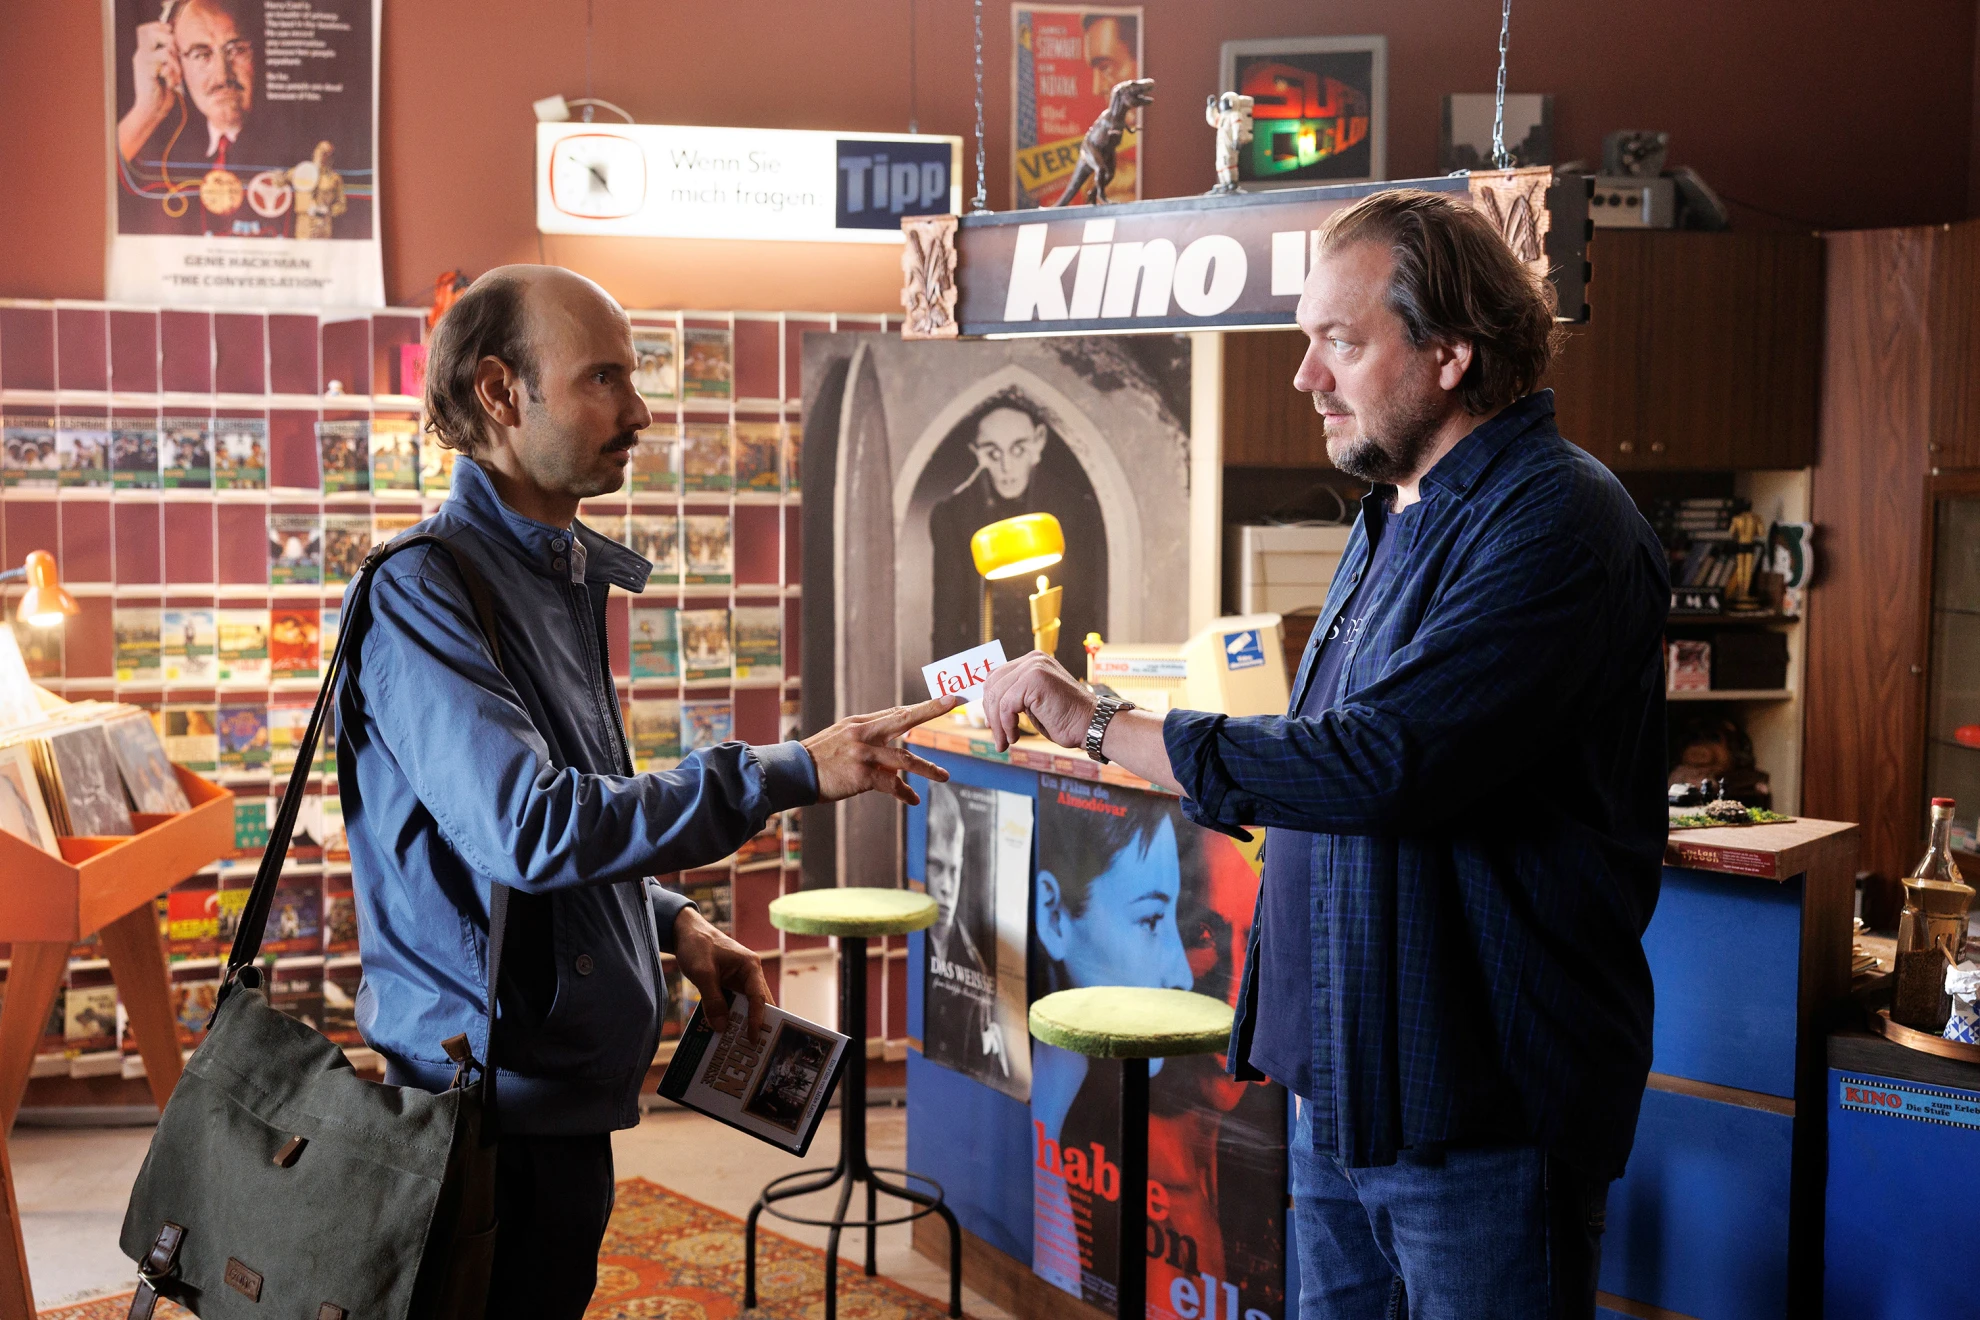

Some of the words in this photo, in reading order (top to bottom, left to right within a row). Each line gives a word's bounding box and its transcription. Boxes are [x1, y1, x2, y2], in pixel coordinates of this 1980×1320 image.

[670, 150, 740, 172] Wenn
[749, 151, 781, 174] Sie
[1020, 141, 1083, 180] VERT
[671, 181, 725, 204] mich
[838, 153, 946, 213] Tipp
[184, 256, 225, 268] GENE
[228, 256, 311, 269] HACKMAN
[1003, 219, 1248, 322] kino
[936, 658, 994, 697] fakt
[1041, 773, 1058, 788] Un
[1060, 776, 1091, 796] Film
[1093, 784, 1110, 800] de
[931, 956, 955, 979] DAS
[813, 1090, 822, 1104] Mike
[1845, 1086, 1902, 1109] KINO
[1931, 1101, 1952, 1110] zum
[806, 1103, 816, 1119] Leigh
[1906, 1103, 1921, 1112] Die
[1924, 1106, 1951, 1117] Stufe
